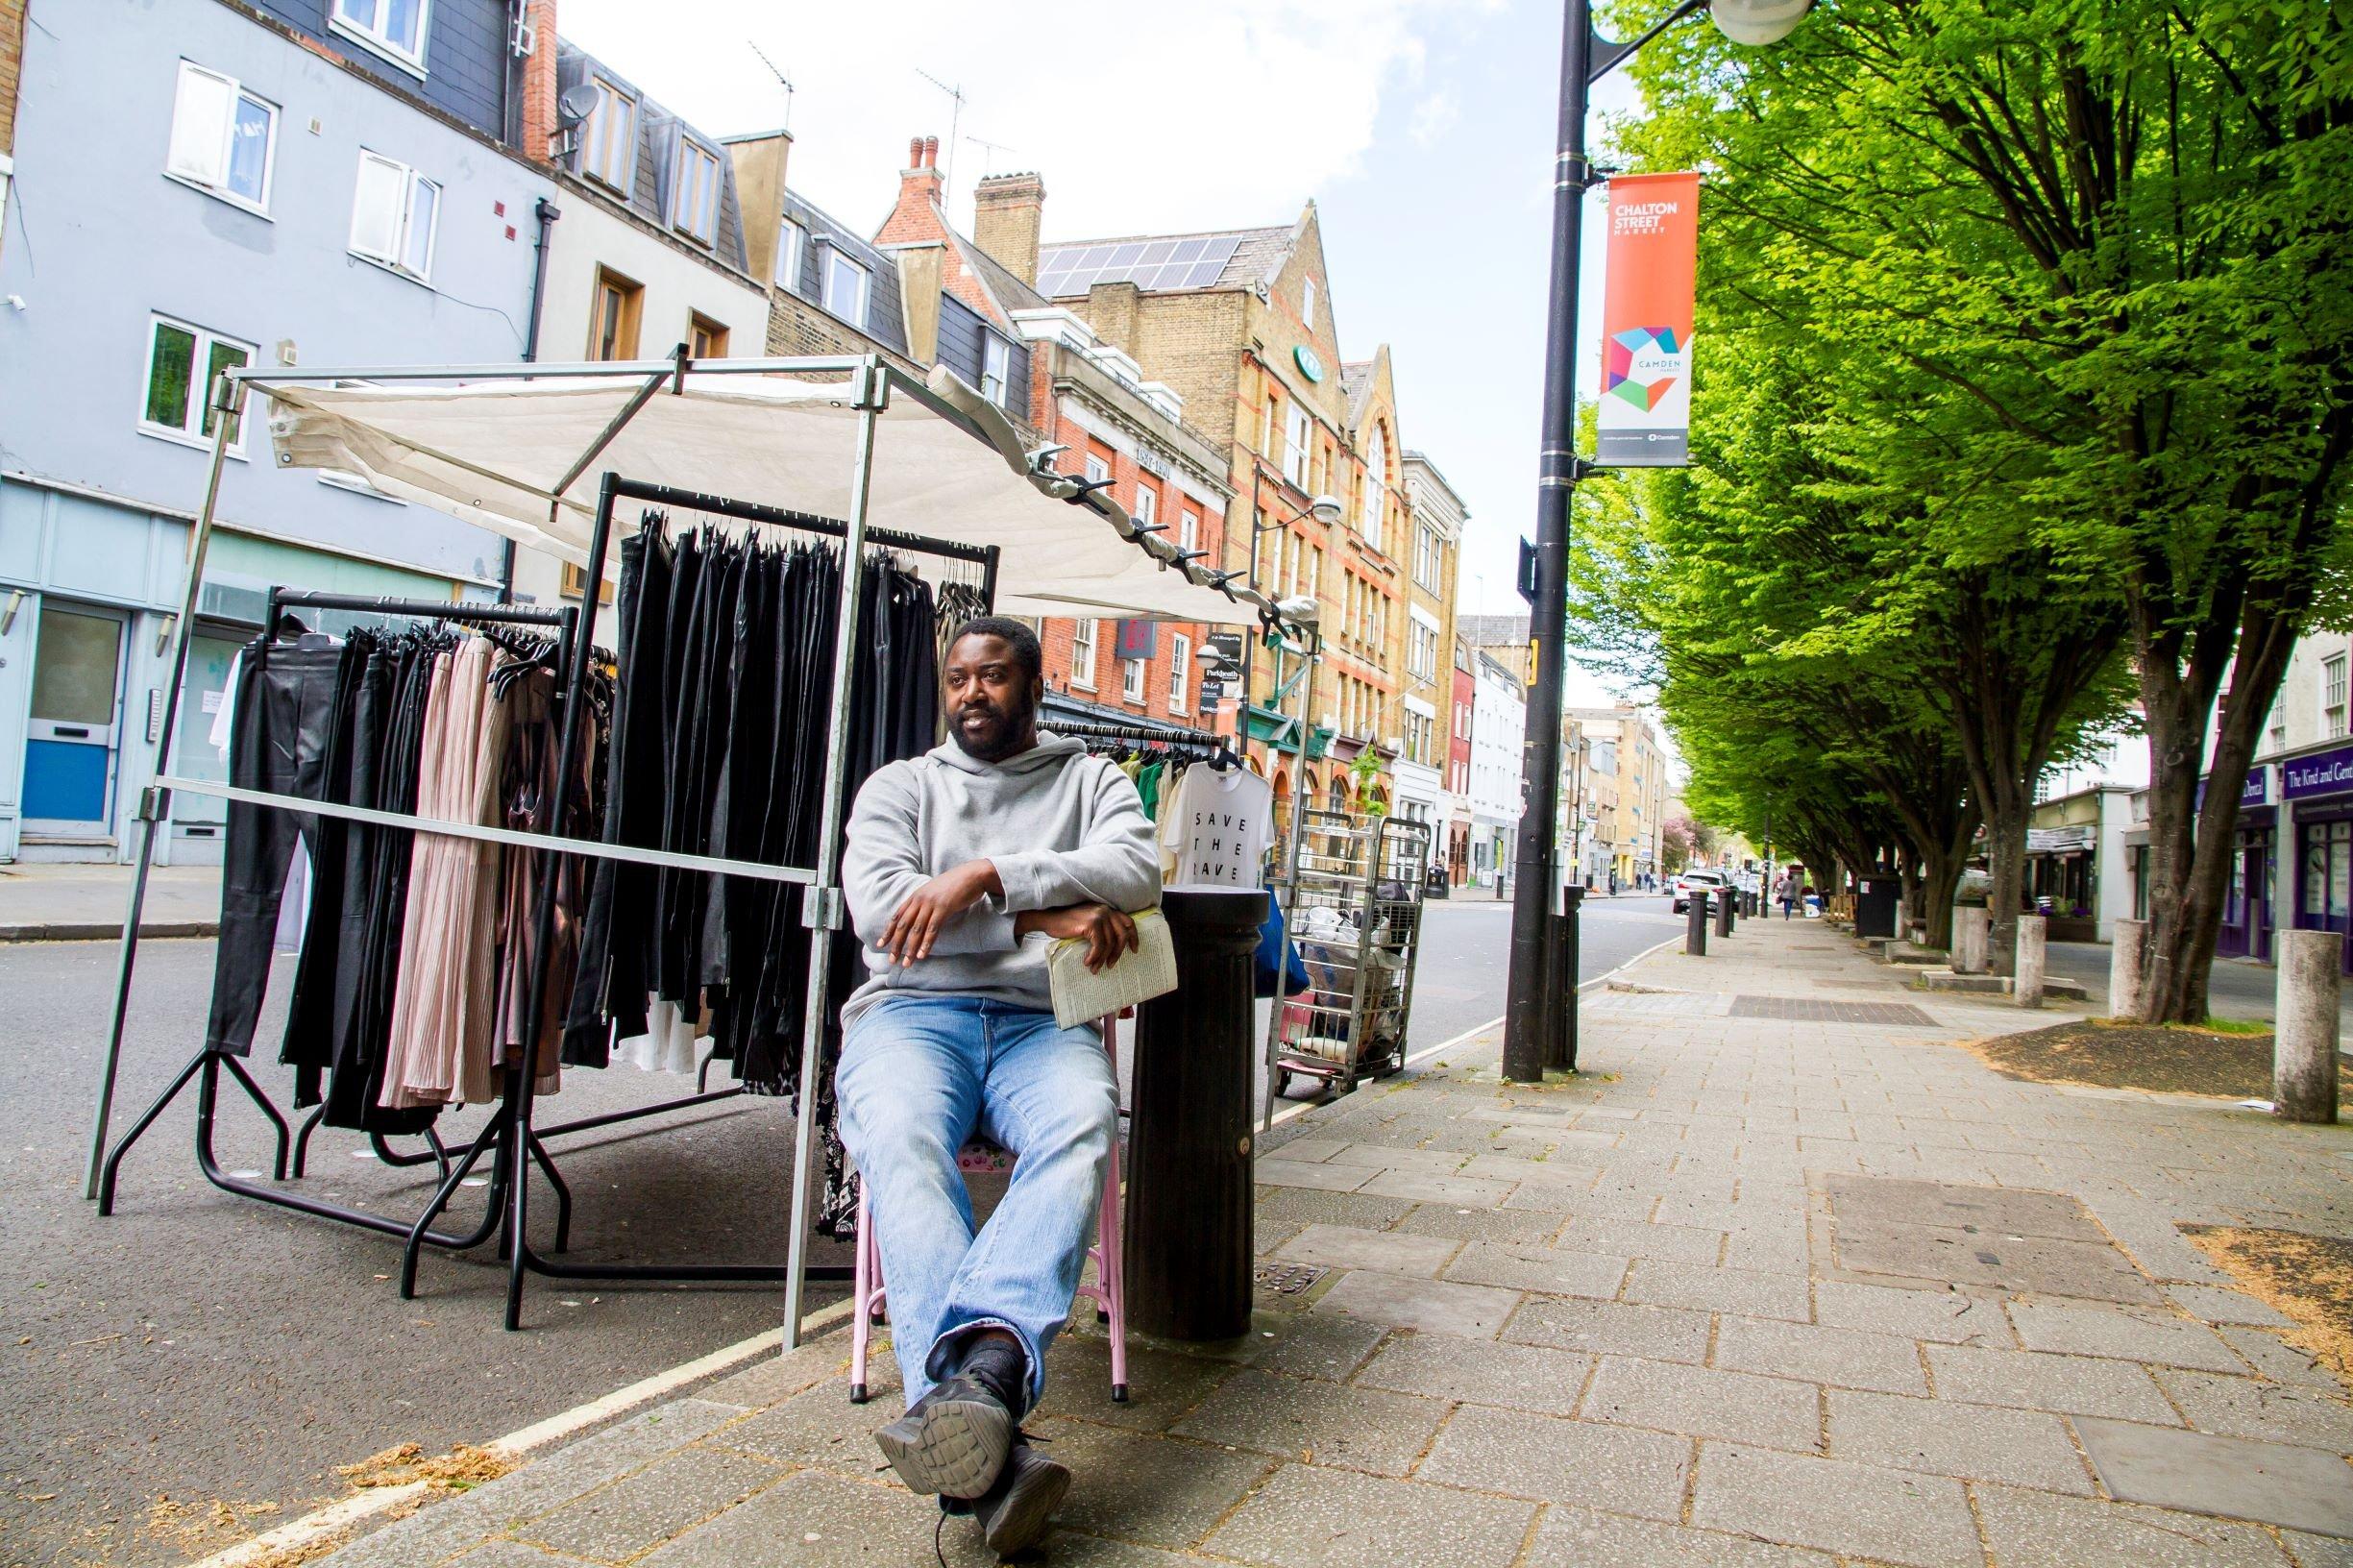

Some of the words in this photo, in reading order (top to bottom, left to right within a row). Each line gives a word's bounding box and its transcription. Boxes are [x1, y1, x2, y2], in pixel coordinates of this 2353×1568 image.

[1615, 203, 1678, 216] CHALTON
[1615, 216, 1661, 229] STREET
[2288, 771, 2301, 788] The
[2302, 767, 2318, 786] Kind
[2319, 764, 2333, 783] and
[2334, 762, 2353, 780] Gent
[1195, 813, 1246, 831] SAVE
[1194, 838, 1241, 856] THE
